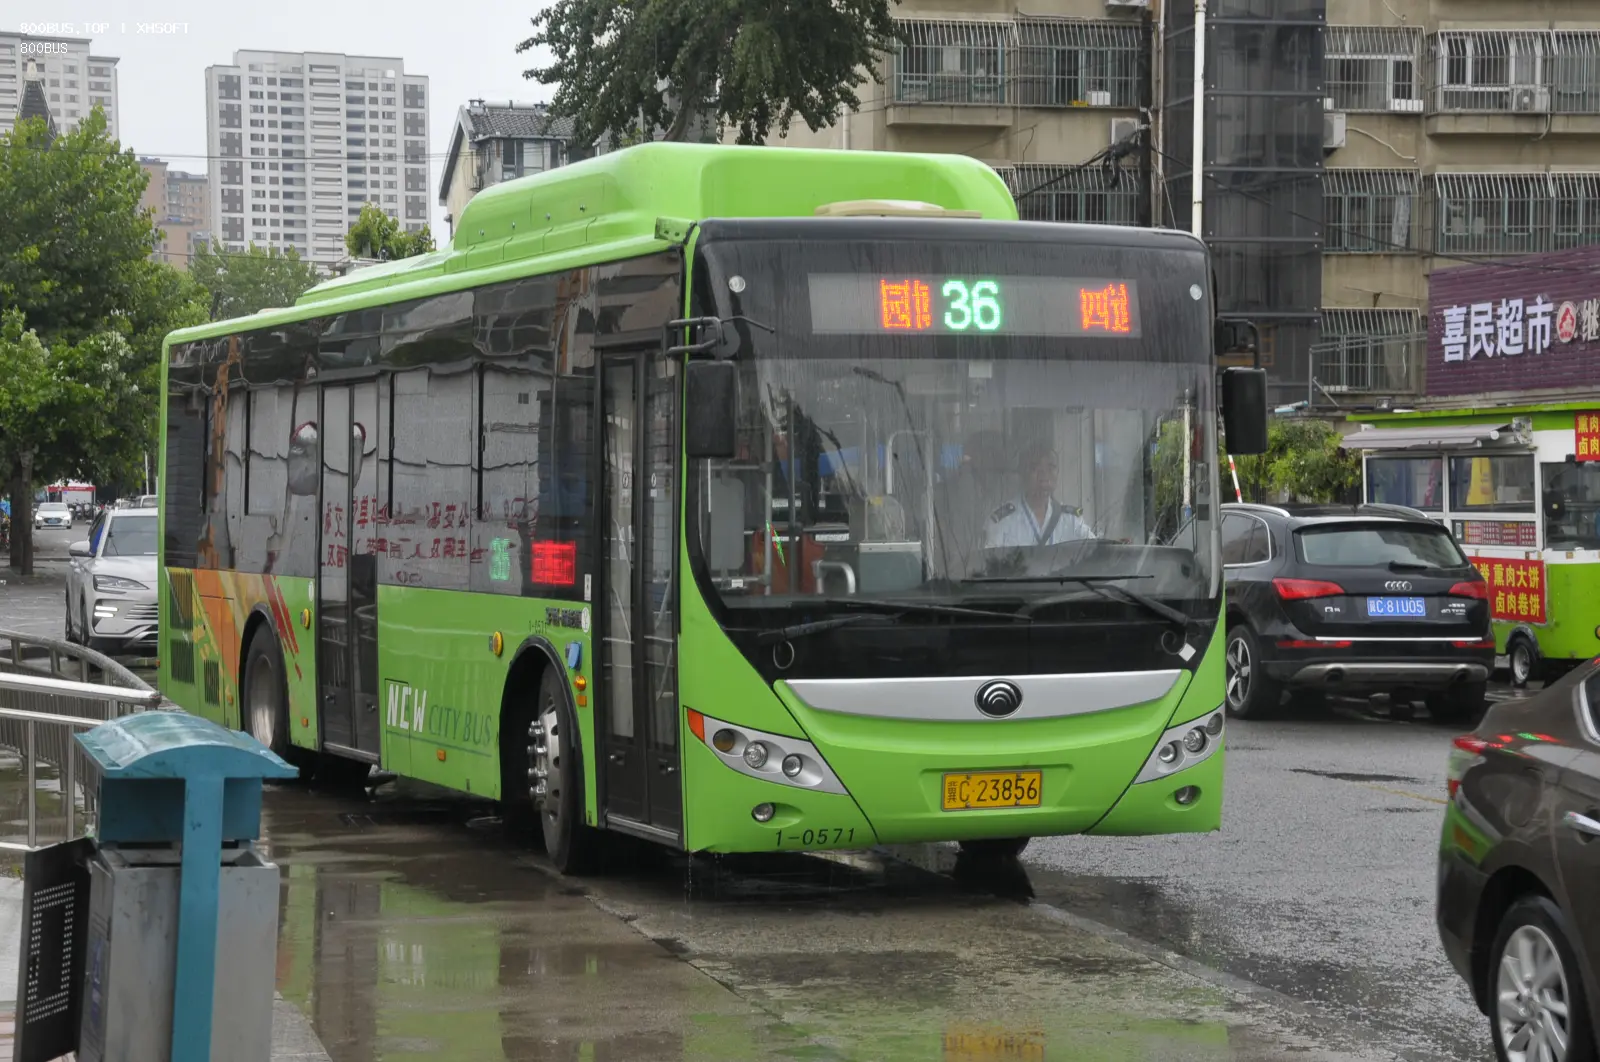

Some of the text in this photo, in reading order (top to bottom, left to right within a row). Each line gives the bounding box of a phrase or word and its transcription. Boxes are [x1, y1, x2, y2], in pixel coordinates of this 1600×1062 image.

[942, 280, 1001, 331] 36
[1441, 295, 1554, 363] 喜民超市
[1493, 563, 1540, 589] 熏肉大饼
[1495, 591, 1541, 617] 卤肉卷饼
[387, 683, 493, 747] NEW CITY BUS
[775, 827, 855, 847] 1-0571
